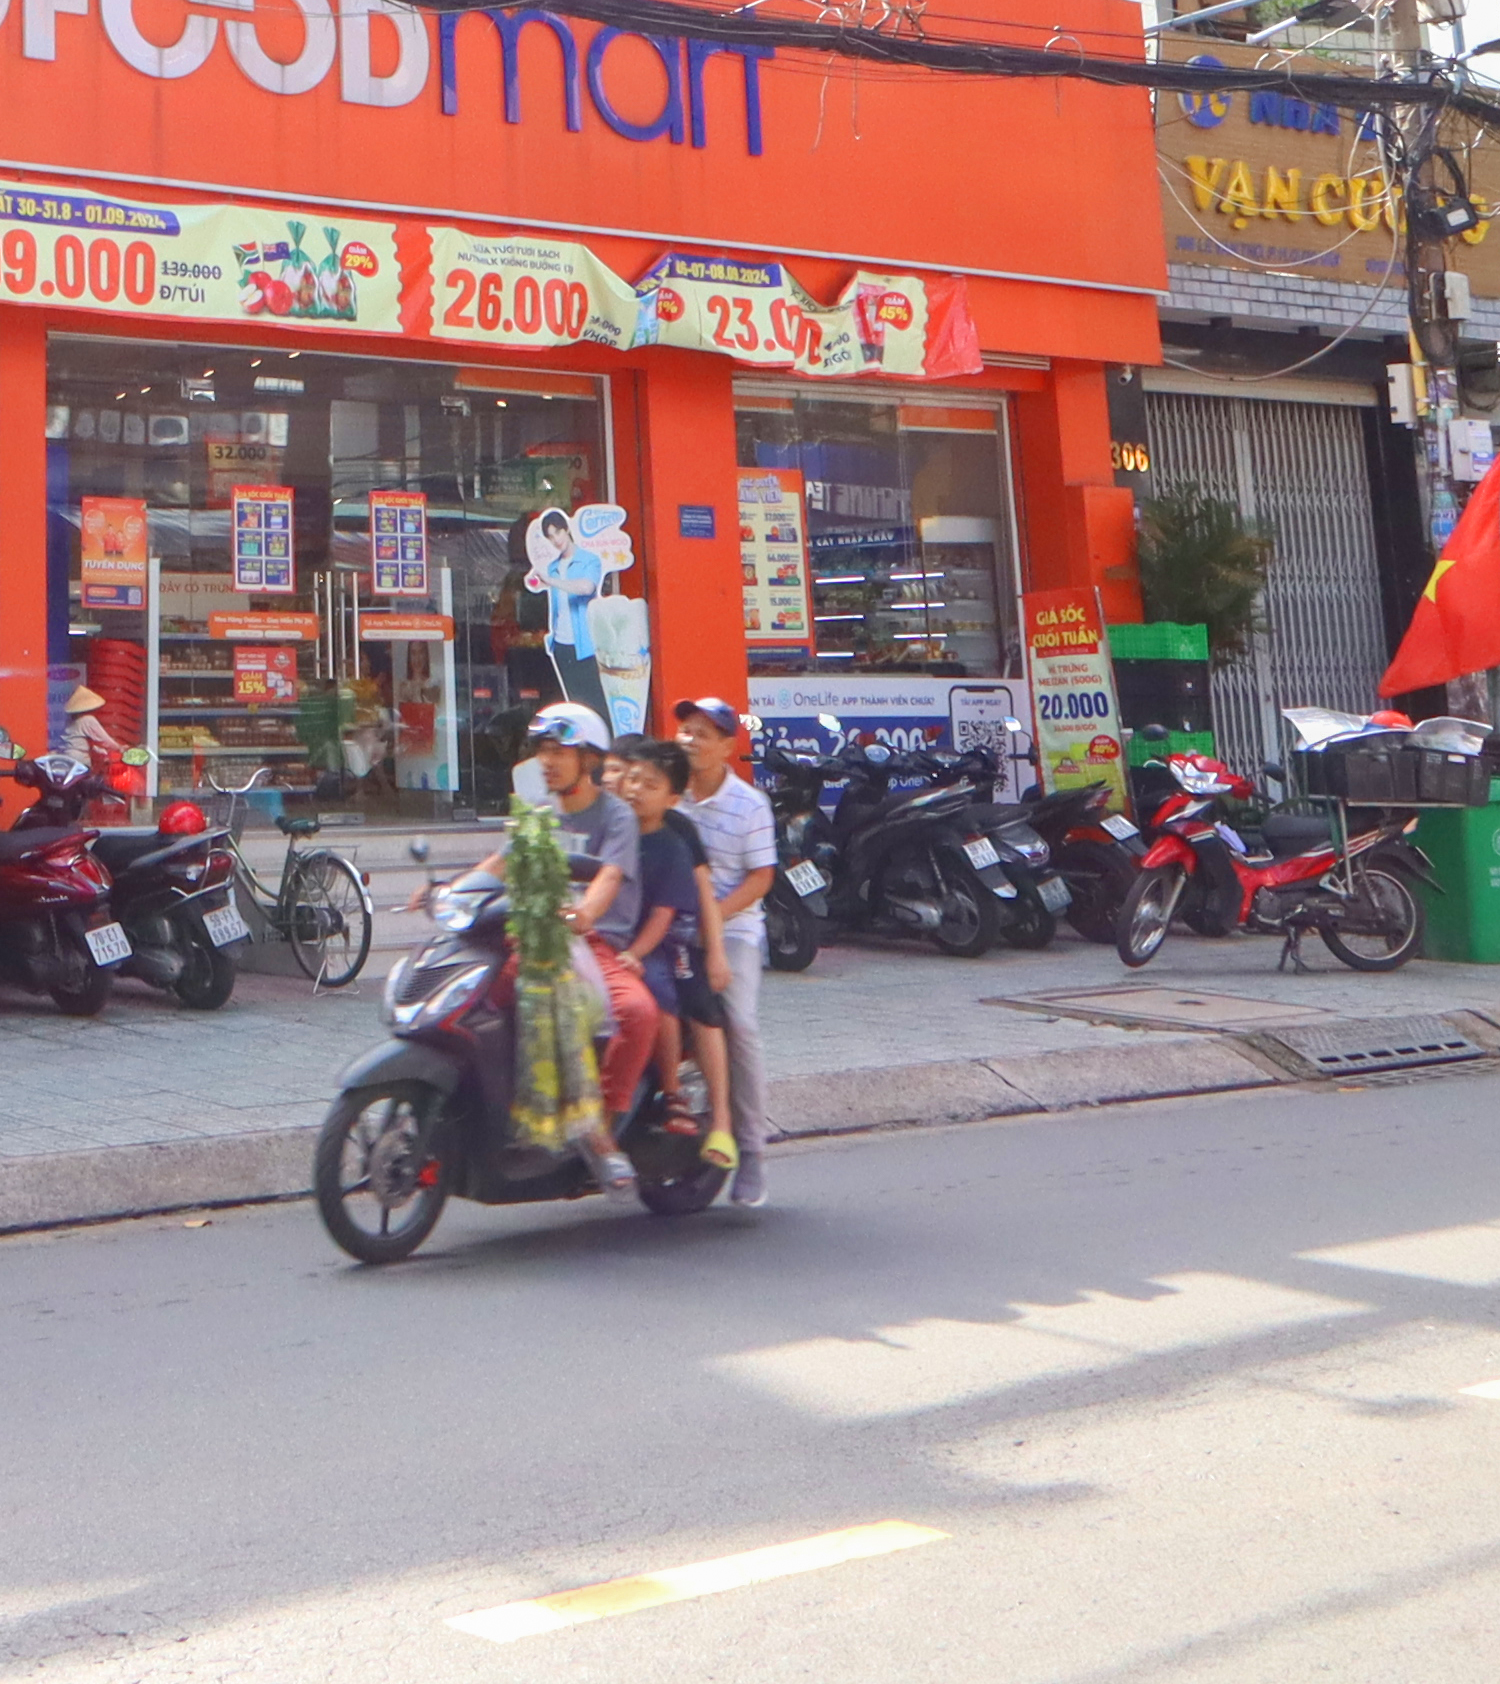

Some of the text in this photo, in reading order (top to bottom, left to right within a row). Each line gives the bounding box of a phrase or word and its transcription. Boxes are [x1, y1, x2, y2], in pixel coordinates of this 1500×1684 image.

[1185, 155, 1301, 230] VẠN
[17, 195, 71, 221] 30-31.8
[86, 205, 167, 230] 01.09.2024
[161, 260, 223, 280] 139.000
[345, 254, 373, 270] 29%
[160, 282, 206, 303] Đ/TÚI
[443, 268, 589, 340] 26.000
[879, 305, 908, 321] 45%
[213, 446, 267, 461] 32.000
[1111, 441, 1150, 473] 306
[1036, 603, 1086, 626] GIÁ SỐC
[1032, 625, 1099, 648] CUỐI TUẦN
[238, 681, 267, 694] 15%
[794, 690, 840, 707] OneLife
[860, 695, 889, 706] THÀNH
[1039, 691, 1110, 721] 20.000
